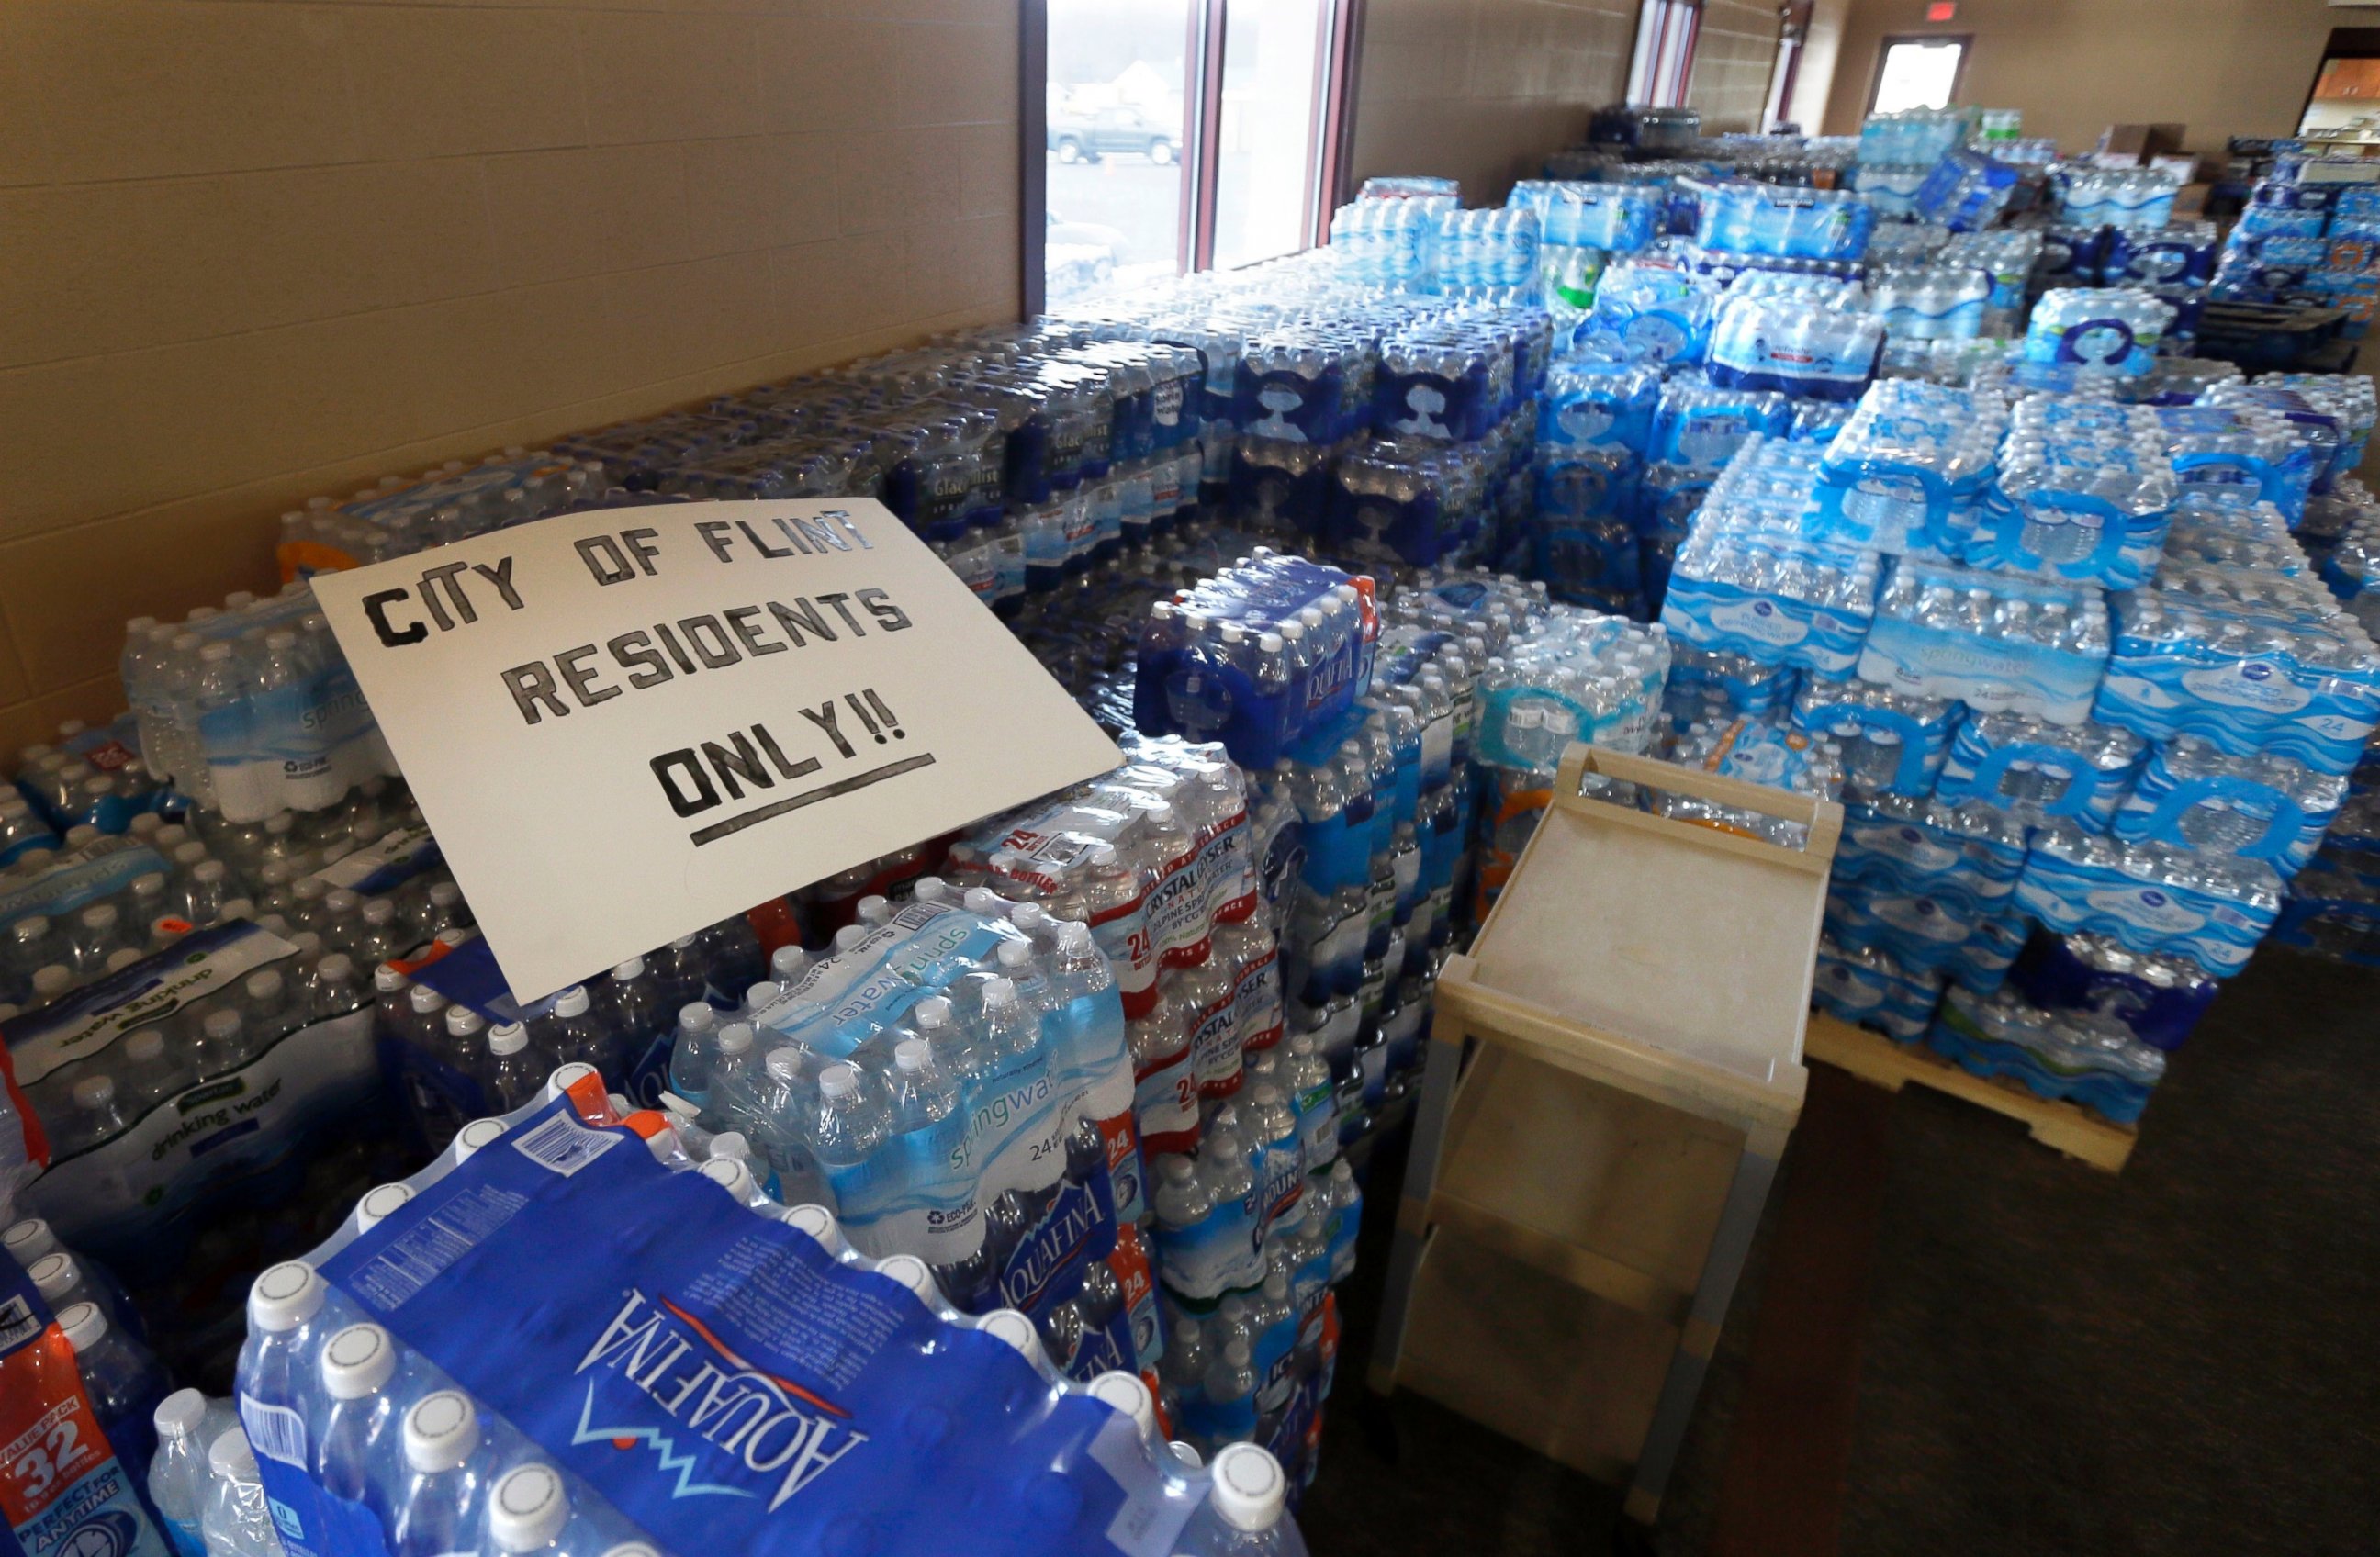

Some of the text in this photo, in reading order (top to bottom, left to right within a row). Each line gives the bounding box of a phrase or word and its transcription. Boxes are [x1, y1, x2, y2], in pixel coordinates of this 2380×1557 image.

[363, 510, 874, 647] CITY OF FLINT
[501, 588, 913, 725] RESIDENTS
[649, 689, 906, 818] ONLY!!
[2319, 717, 2345, 733] 24
[1001, 828, 1040, 851] 24
[151, 1077, 282, 1161] drinking water
[1029, 1139, 1052, 1162] 24
[1106, 1127, 1129, 1160] 24
[998, 1182, 1105, 1309] AQUAFINA
[1124, 1271, 1145, 1302] 24
[0, 1397, 79, 1465] VALUE PACK
[575, 1287, 869, 1513] AQUAFINA
[15, 1418, 89, 1498] 32
[61, 1447, 102, 1479] bottles
[17, 1465, 120, 1543] PERFECT FOR
[38, 1480, 119, 1552] ANYTIME
